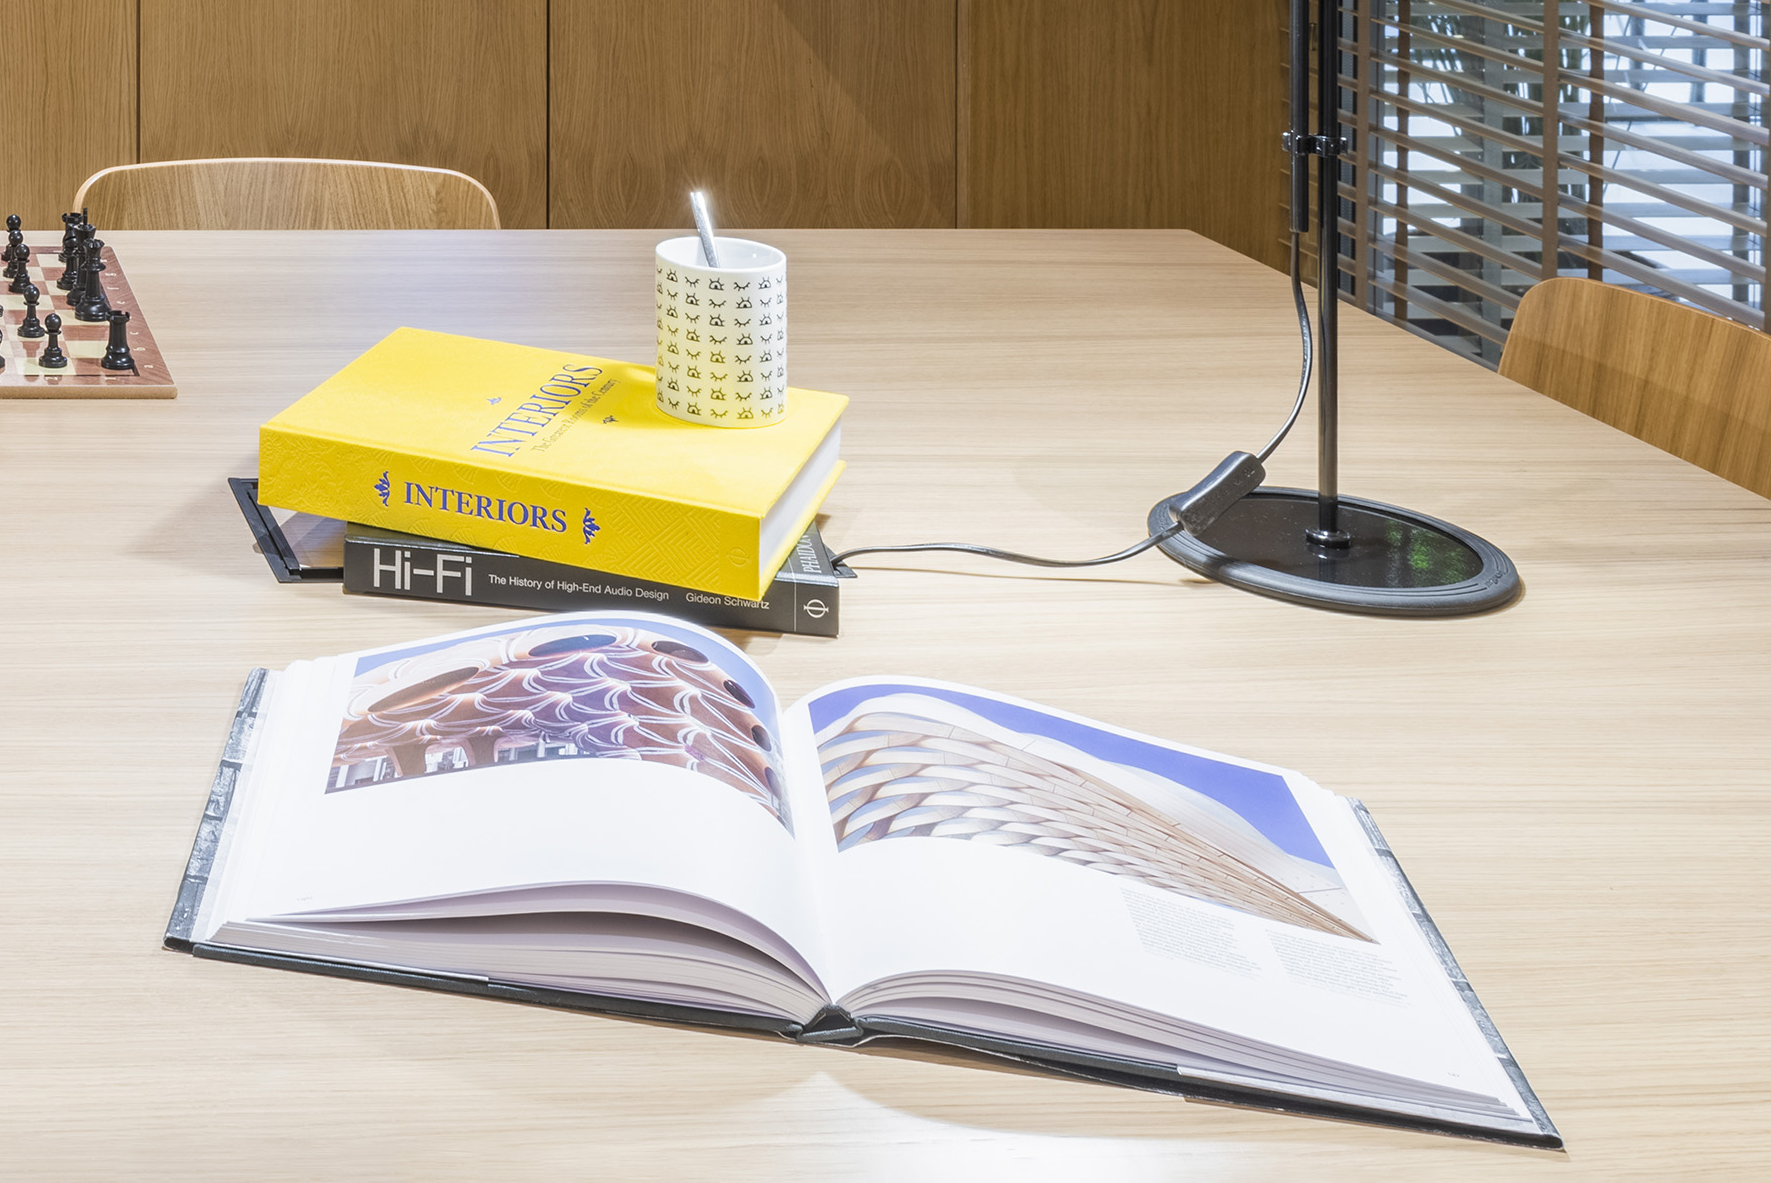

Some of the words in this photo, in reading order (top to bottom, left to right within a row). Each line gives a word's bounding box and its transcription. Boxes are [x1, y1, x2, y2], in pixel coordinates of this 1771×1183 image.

[470, 363, 603, 458] INTERIORS
[404, 481, 567, 533] INTERIORS
[373, 548, 472, 596] Hi-Fi
[488, 573, 507, 585] The
[509, 575, 543, 590] History
[544, 579, 556, 590] of
[557, 581, 602, 595] High-End
[603, 584, 633, 597] Audio
[635, 587, 670, 601] Design
[685, 592, 722, 605] Gideon
[724, 596, 770, 610] Schwartz
